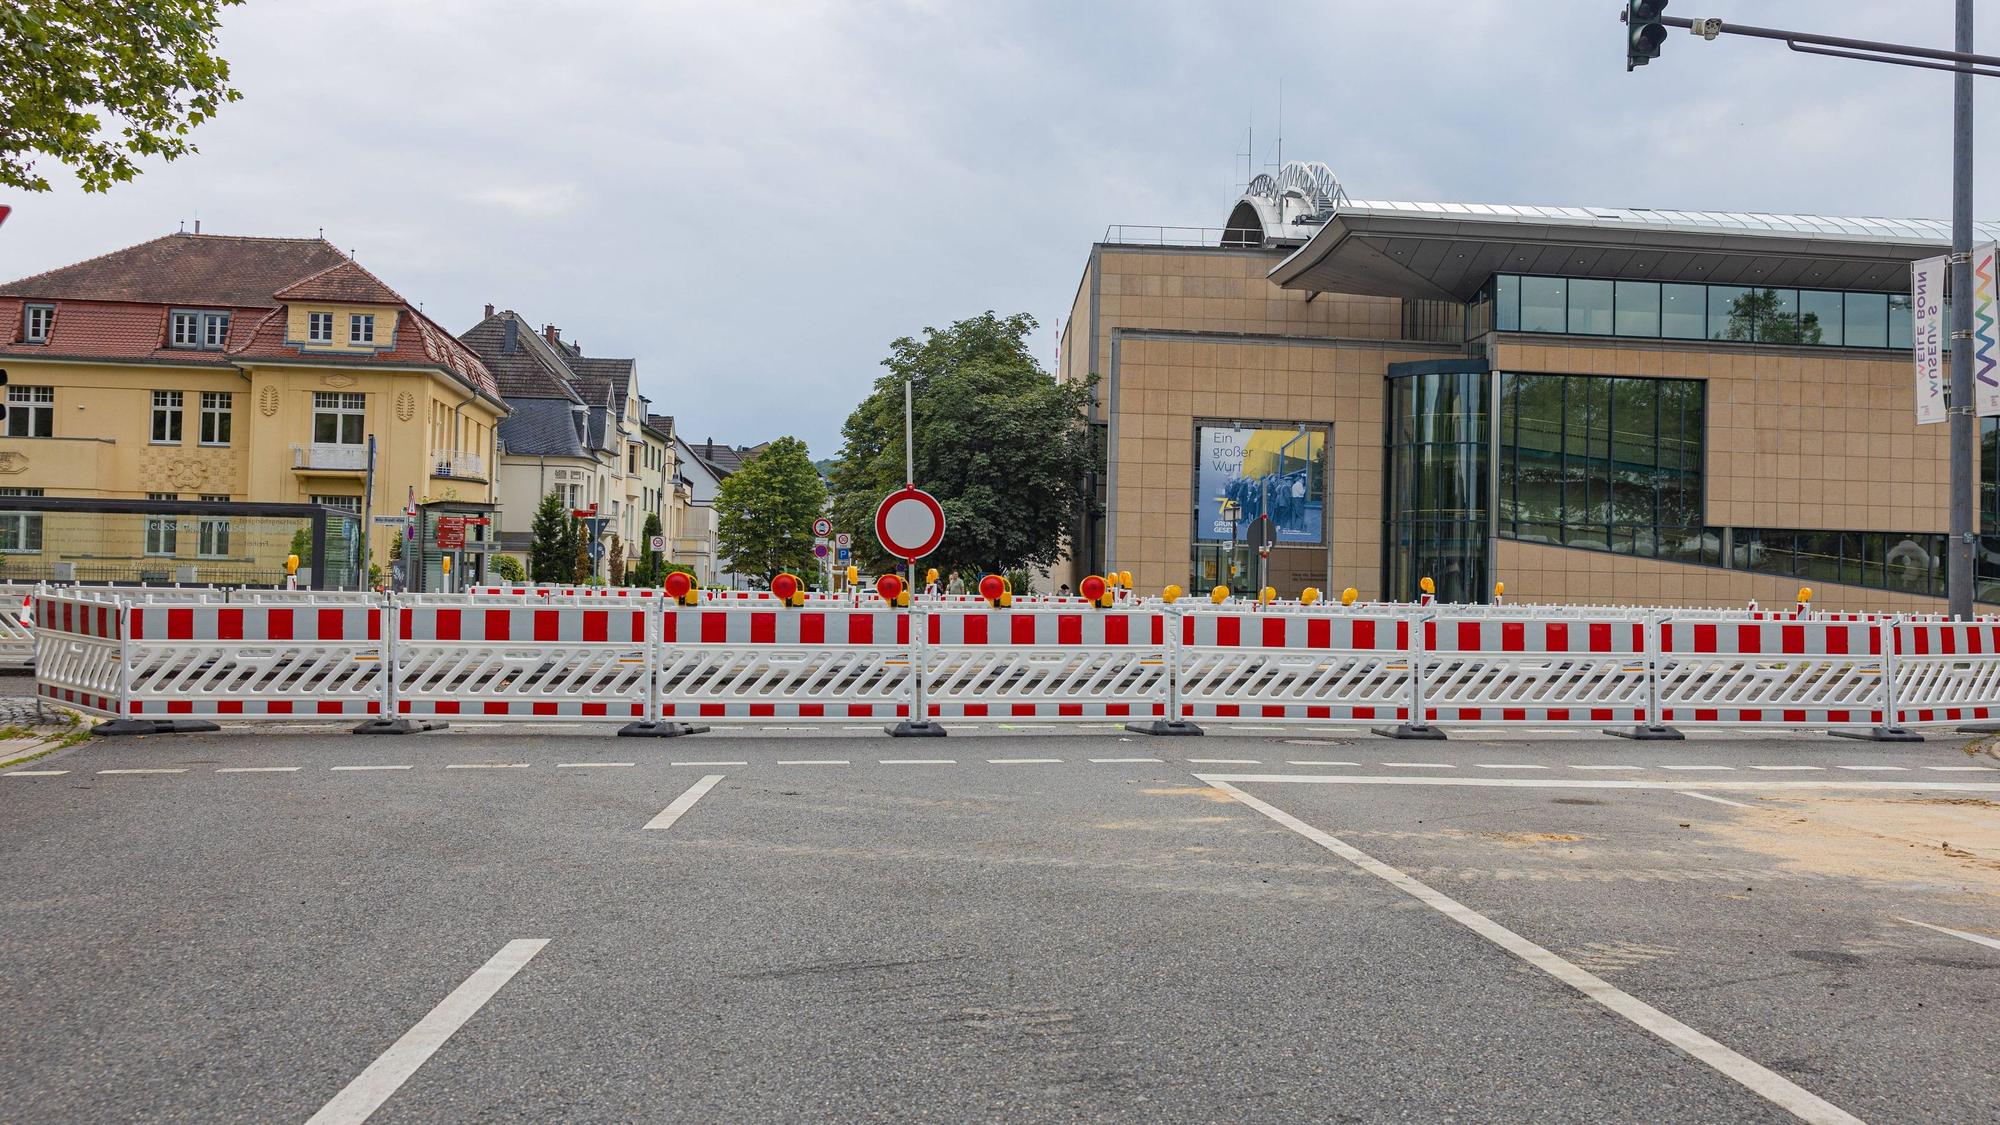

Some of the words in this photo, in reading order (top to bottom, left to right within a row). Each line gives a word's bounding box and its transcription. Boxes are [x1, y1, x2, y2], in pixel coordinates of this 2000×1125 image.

[1213, 432, 1233, 444] Ein
[1212, 446, 1254, 459] großer
[1212, 460, 1243, 472] Wurf
